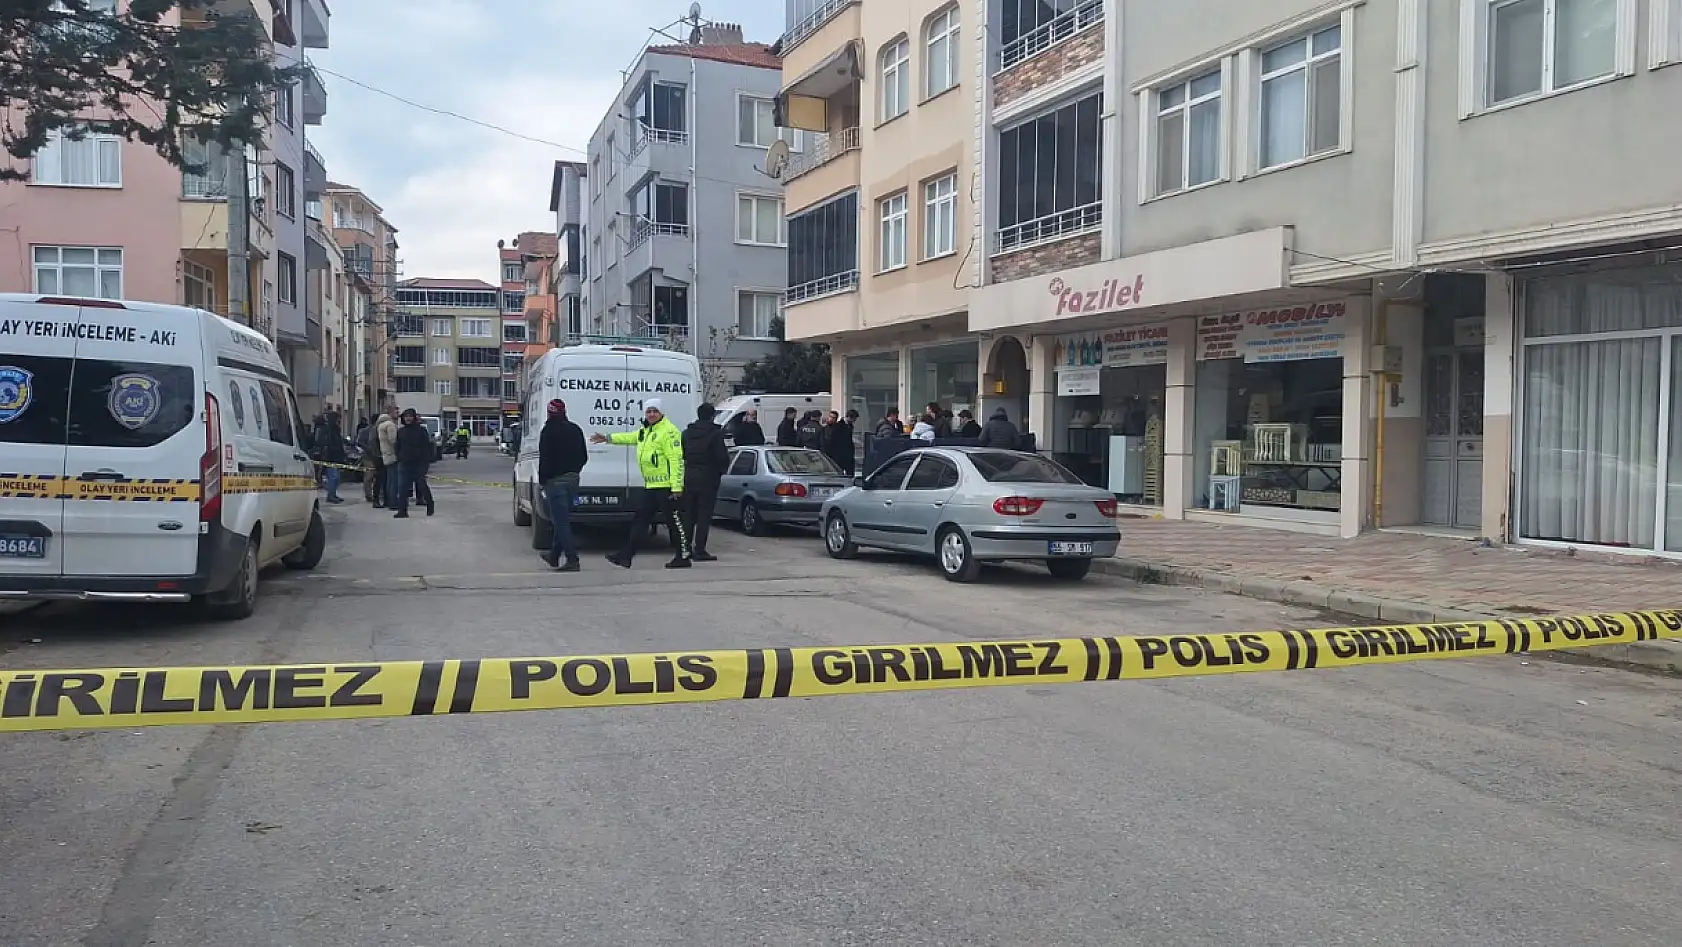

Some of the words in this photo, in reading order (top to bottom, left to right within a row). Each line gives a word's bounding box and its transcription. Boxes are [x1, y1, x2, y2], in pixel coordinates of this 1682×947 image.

[0, 319, 21, 335] AY
[24, 320, 57, 338] YERİ
[61, 322, 137, 342] İNCELEME
[150, 329, 176, 346] AKİ
[560, 379, 610, 390] CENAZE
[614, 379, 652, 392] NAKİL
[655, 382, 691, 394] ARACI
[594, 399, 620, 411] ALO
[589, 416, 614, 426] 0362
[80, 484, 105, 493] OLAY
[0, 665, 382, 718] İRİLMEZ
[510, 655, 717, 699] POLİS
[811, 642, 1068, 686] GİRİLMEZ
[1134, 634, 1270, 670] POLİS
[1325, 623, 1496, 658] GİRİLMEZ
[1538, 613, 1624, 643] POLİS
